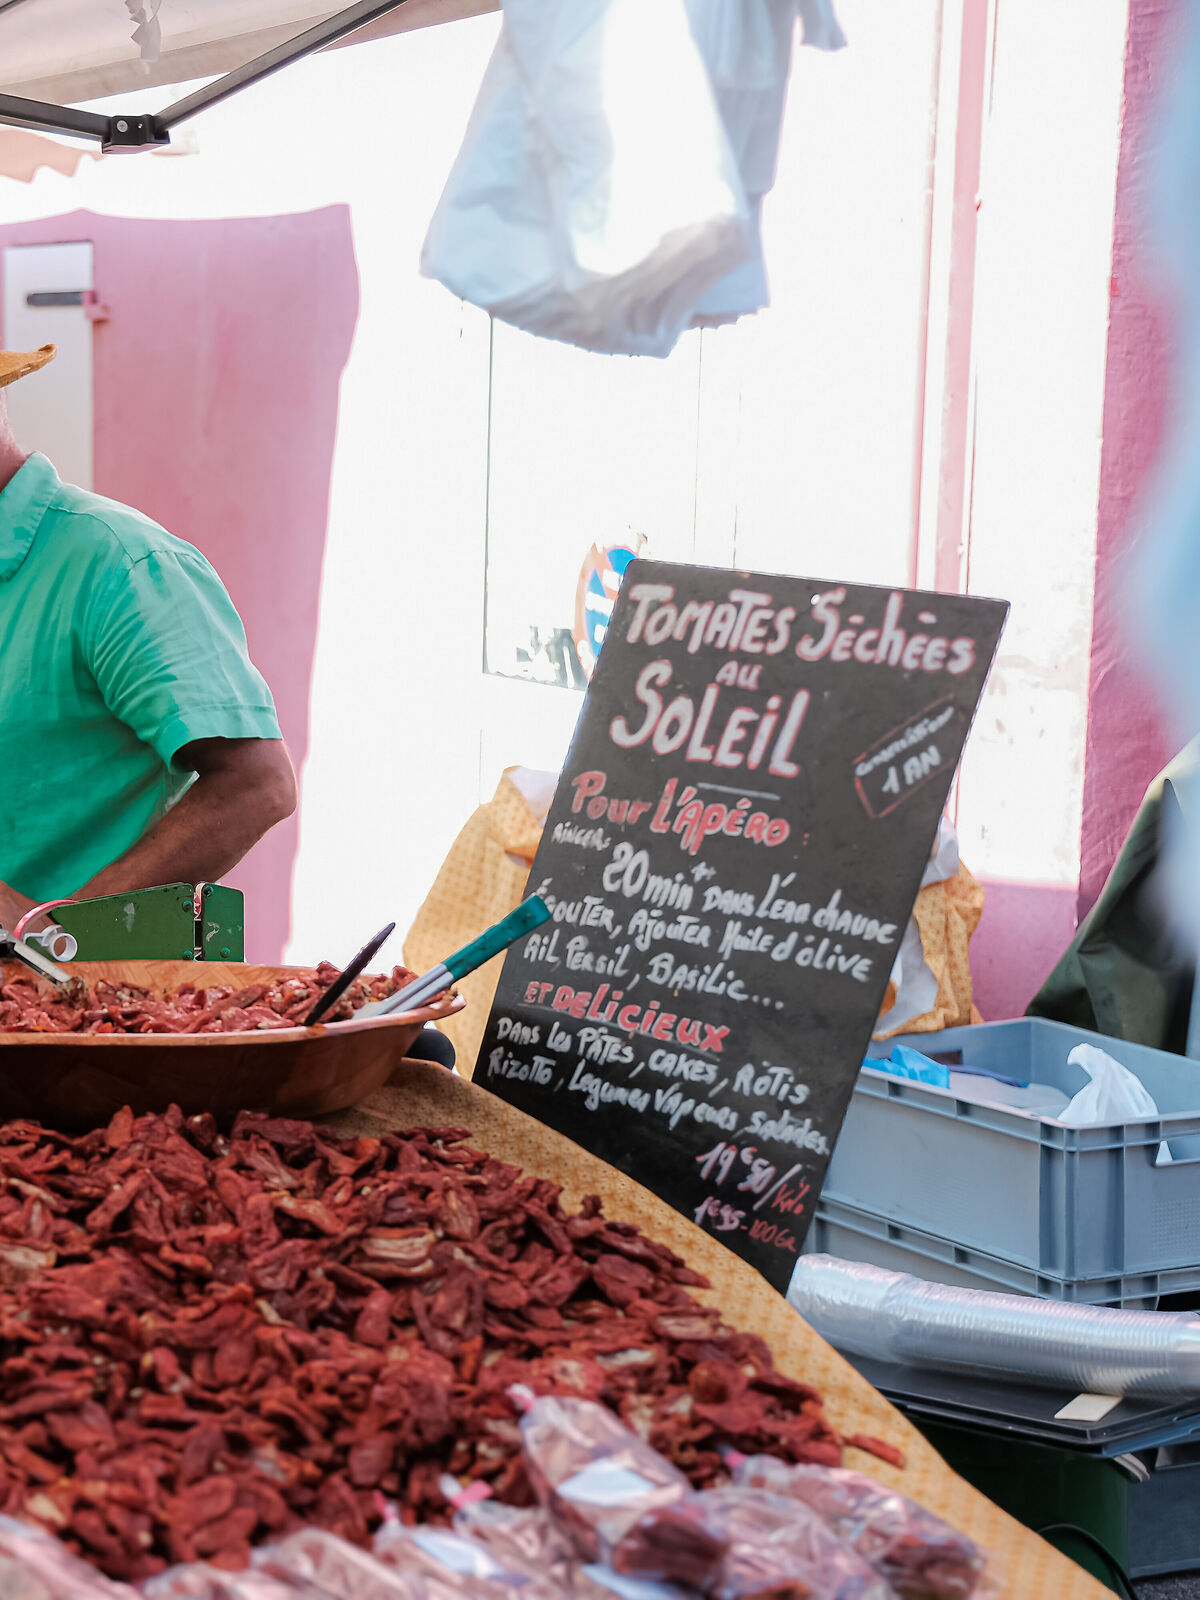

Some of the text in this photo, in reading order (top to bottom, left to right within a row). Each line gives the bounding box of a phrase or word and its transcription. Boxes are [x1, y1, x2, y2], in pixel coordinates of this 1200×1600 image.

[626, 583, 796, 656] TOMATES
[715, 661, 763, 690] AU
[882, 745, 942, 793] 1 AN
